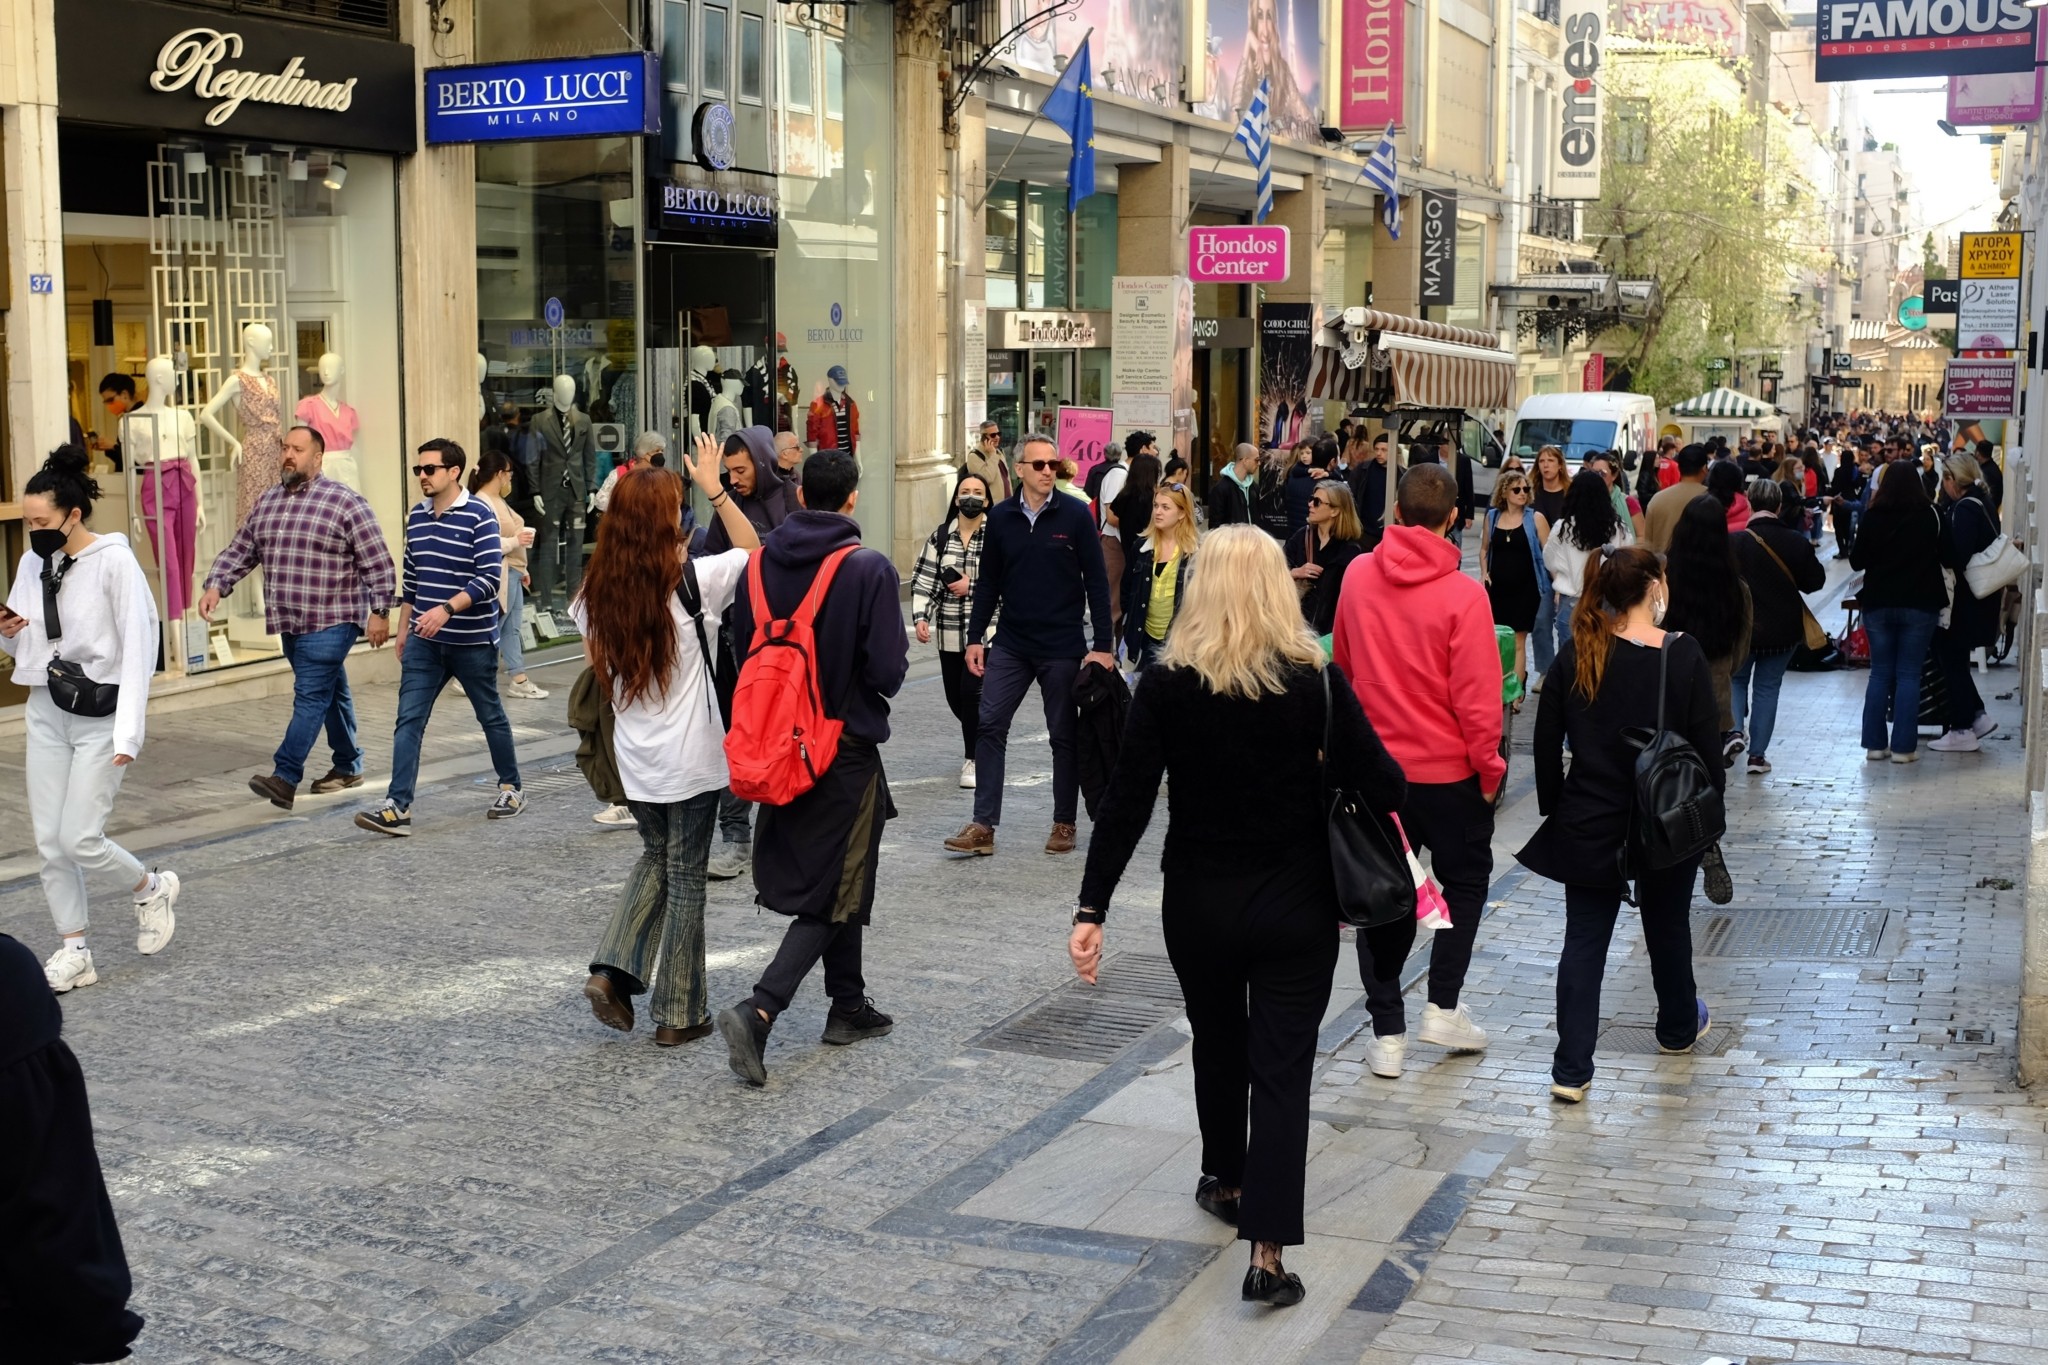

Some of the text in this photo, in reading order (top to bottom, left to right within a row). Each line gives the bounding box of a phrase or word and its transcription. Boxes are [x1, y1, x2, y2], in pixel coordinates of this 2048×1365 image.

[1821, 4, 1830, 41] CLUB
[1831, 0, 2033, 41] FAMOUS
[1352, 0, 1391, 105] Hon
[1831, 34, 2022, 55] shoes stores
[150, 27, 358, 127] Regalinas
[437, 77, 526, 109] BERTO
[1560, 12, 1600, 167] emes
[487, 109, 578, 126] MILANO
[664, 186, 771, 218] BERTO LUCCI
[690, 217, 748, 229] MILANO
[1197, 234, 1278, 254] Hondos
[1423, 198, 1443, 296] MANGO
[1972, 236, 2011, 248] ΑΓΟΡΑ
[1968, 249, 2015, 261] ΧΡΥΣΟΥ
[1197, 254, 1269, 275] Center
[32, 276, 51, 291] 37
[1931, 286, 1958, 303] Pas
[1985, 298, 2016, 306] Solution
[1192, 320, 1219, 337] ANGO
[1287, 319, 1311, 329] GIRL
[807, 328, 863, 341] BERTO LUCCI
[1949, 367, 2014, 378] ΕΠΙΔΙΟΡΘΩΣΕΙΣ
[1948, 393, 2011, 405] e-paramana
